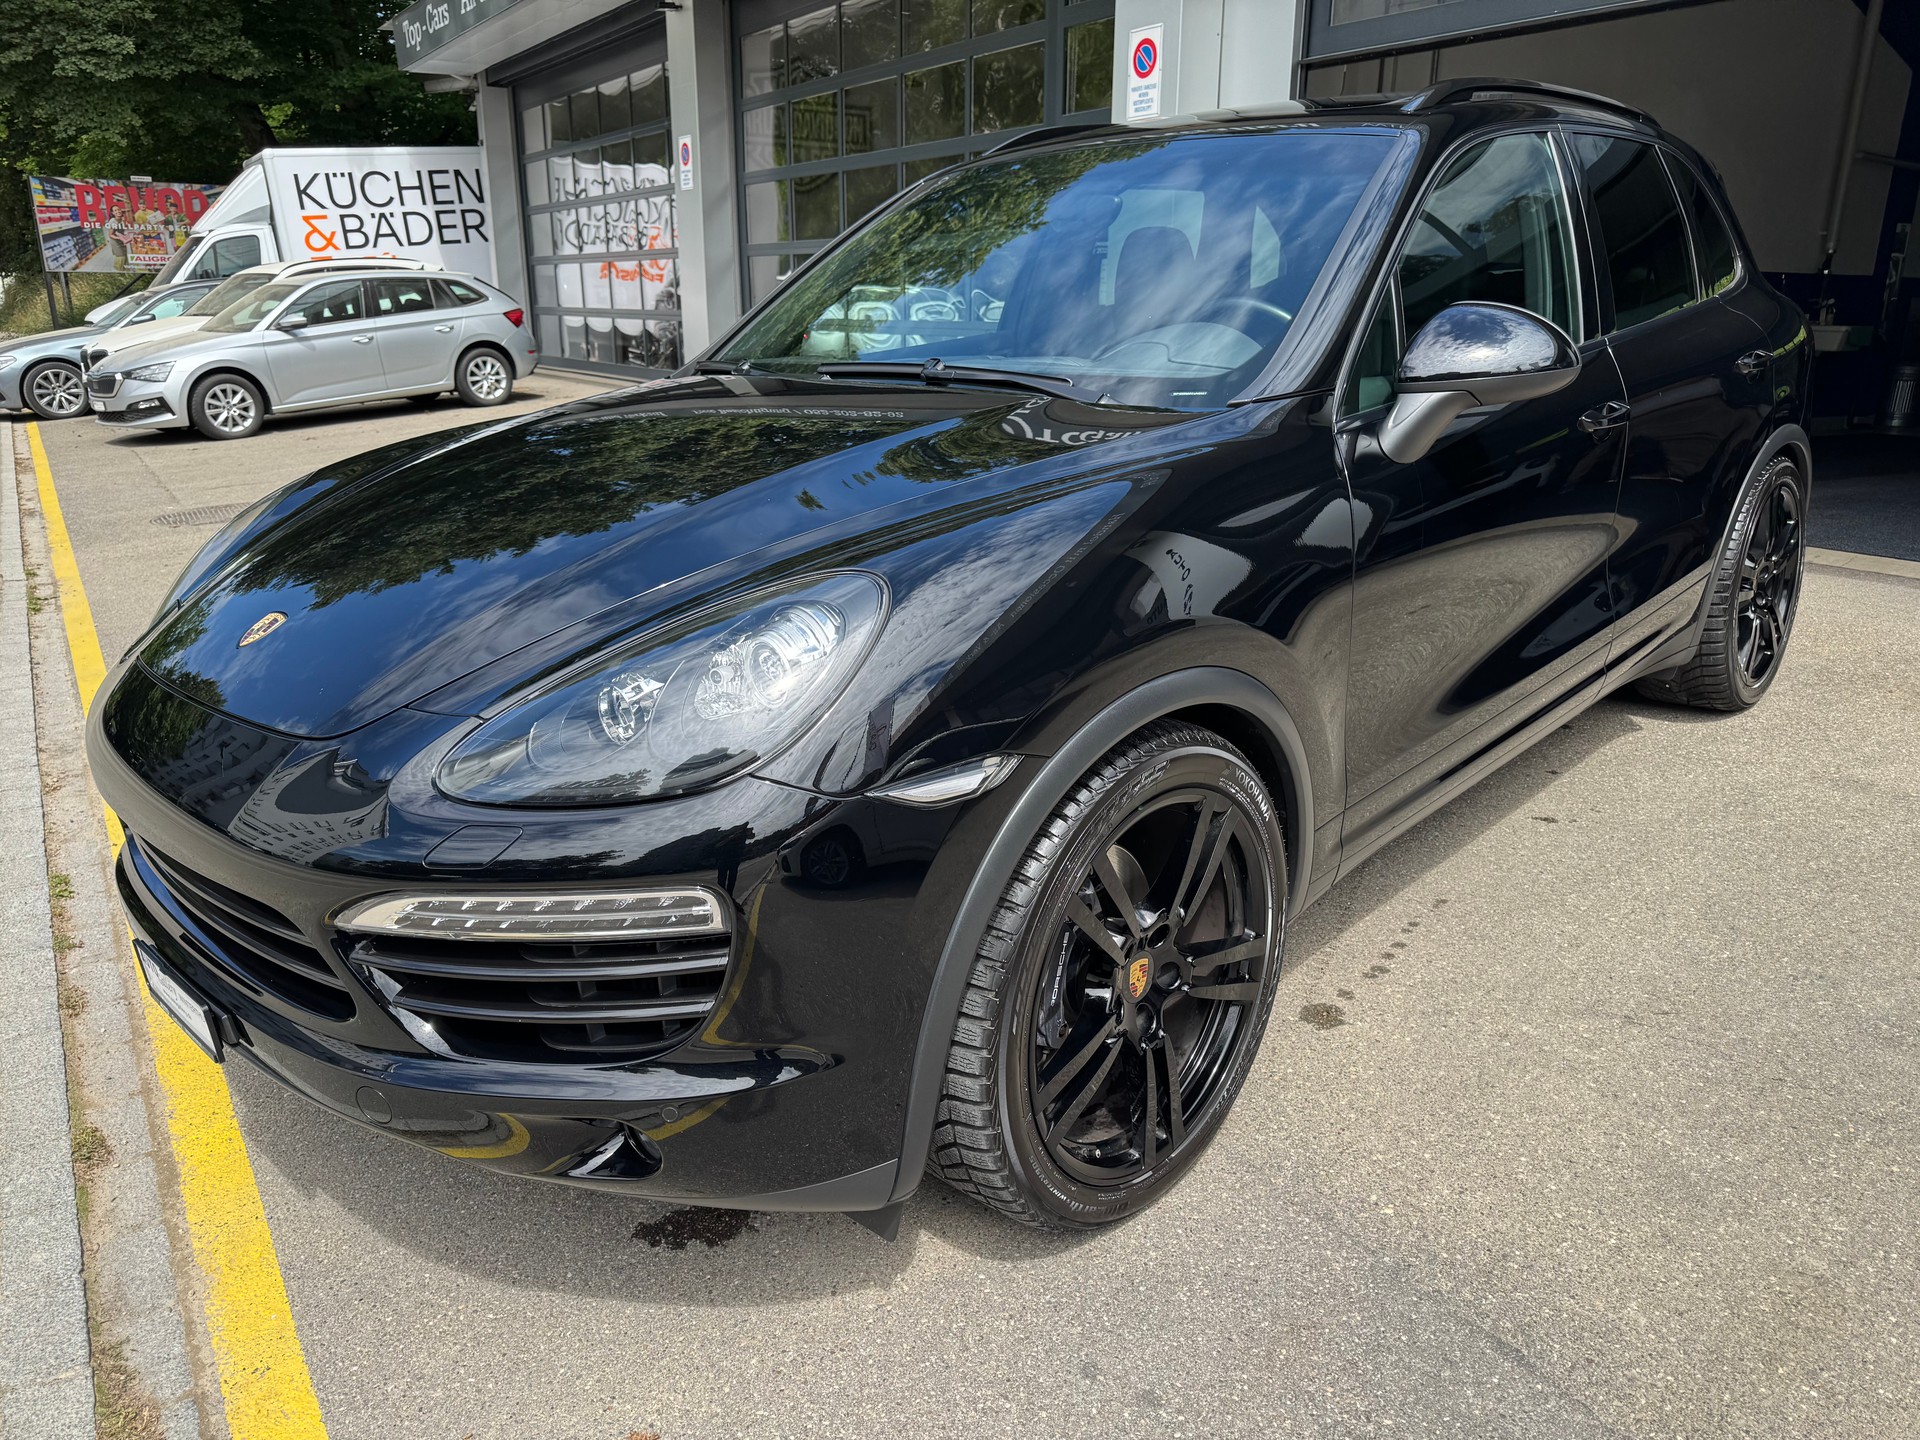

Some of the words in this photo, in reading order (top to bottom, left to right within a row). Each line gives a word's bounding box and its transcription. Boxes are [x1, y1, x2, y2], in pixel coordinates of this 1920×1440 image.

[402, 3, 450, 51] Top-Cars
[293, 168, 485, 210] KÜCHEN
[84, 221, 101, 229] DIE
[105, 222, 165, 232] GRILLPARTY
[1235, 767, 1272, 822] YOKOHAMA
